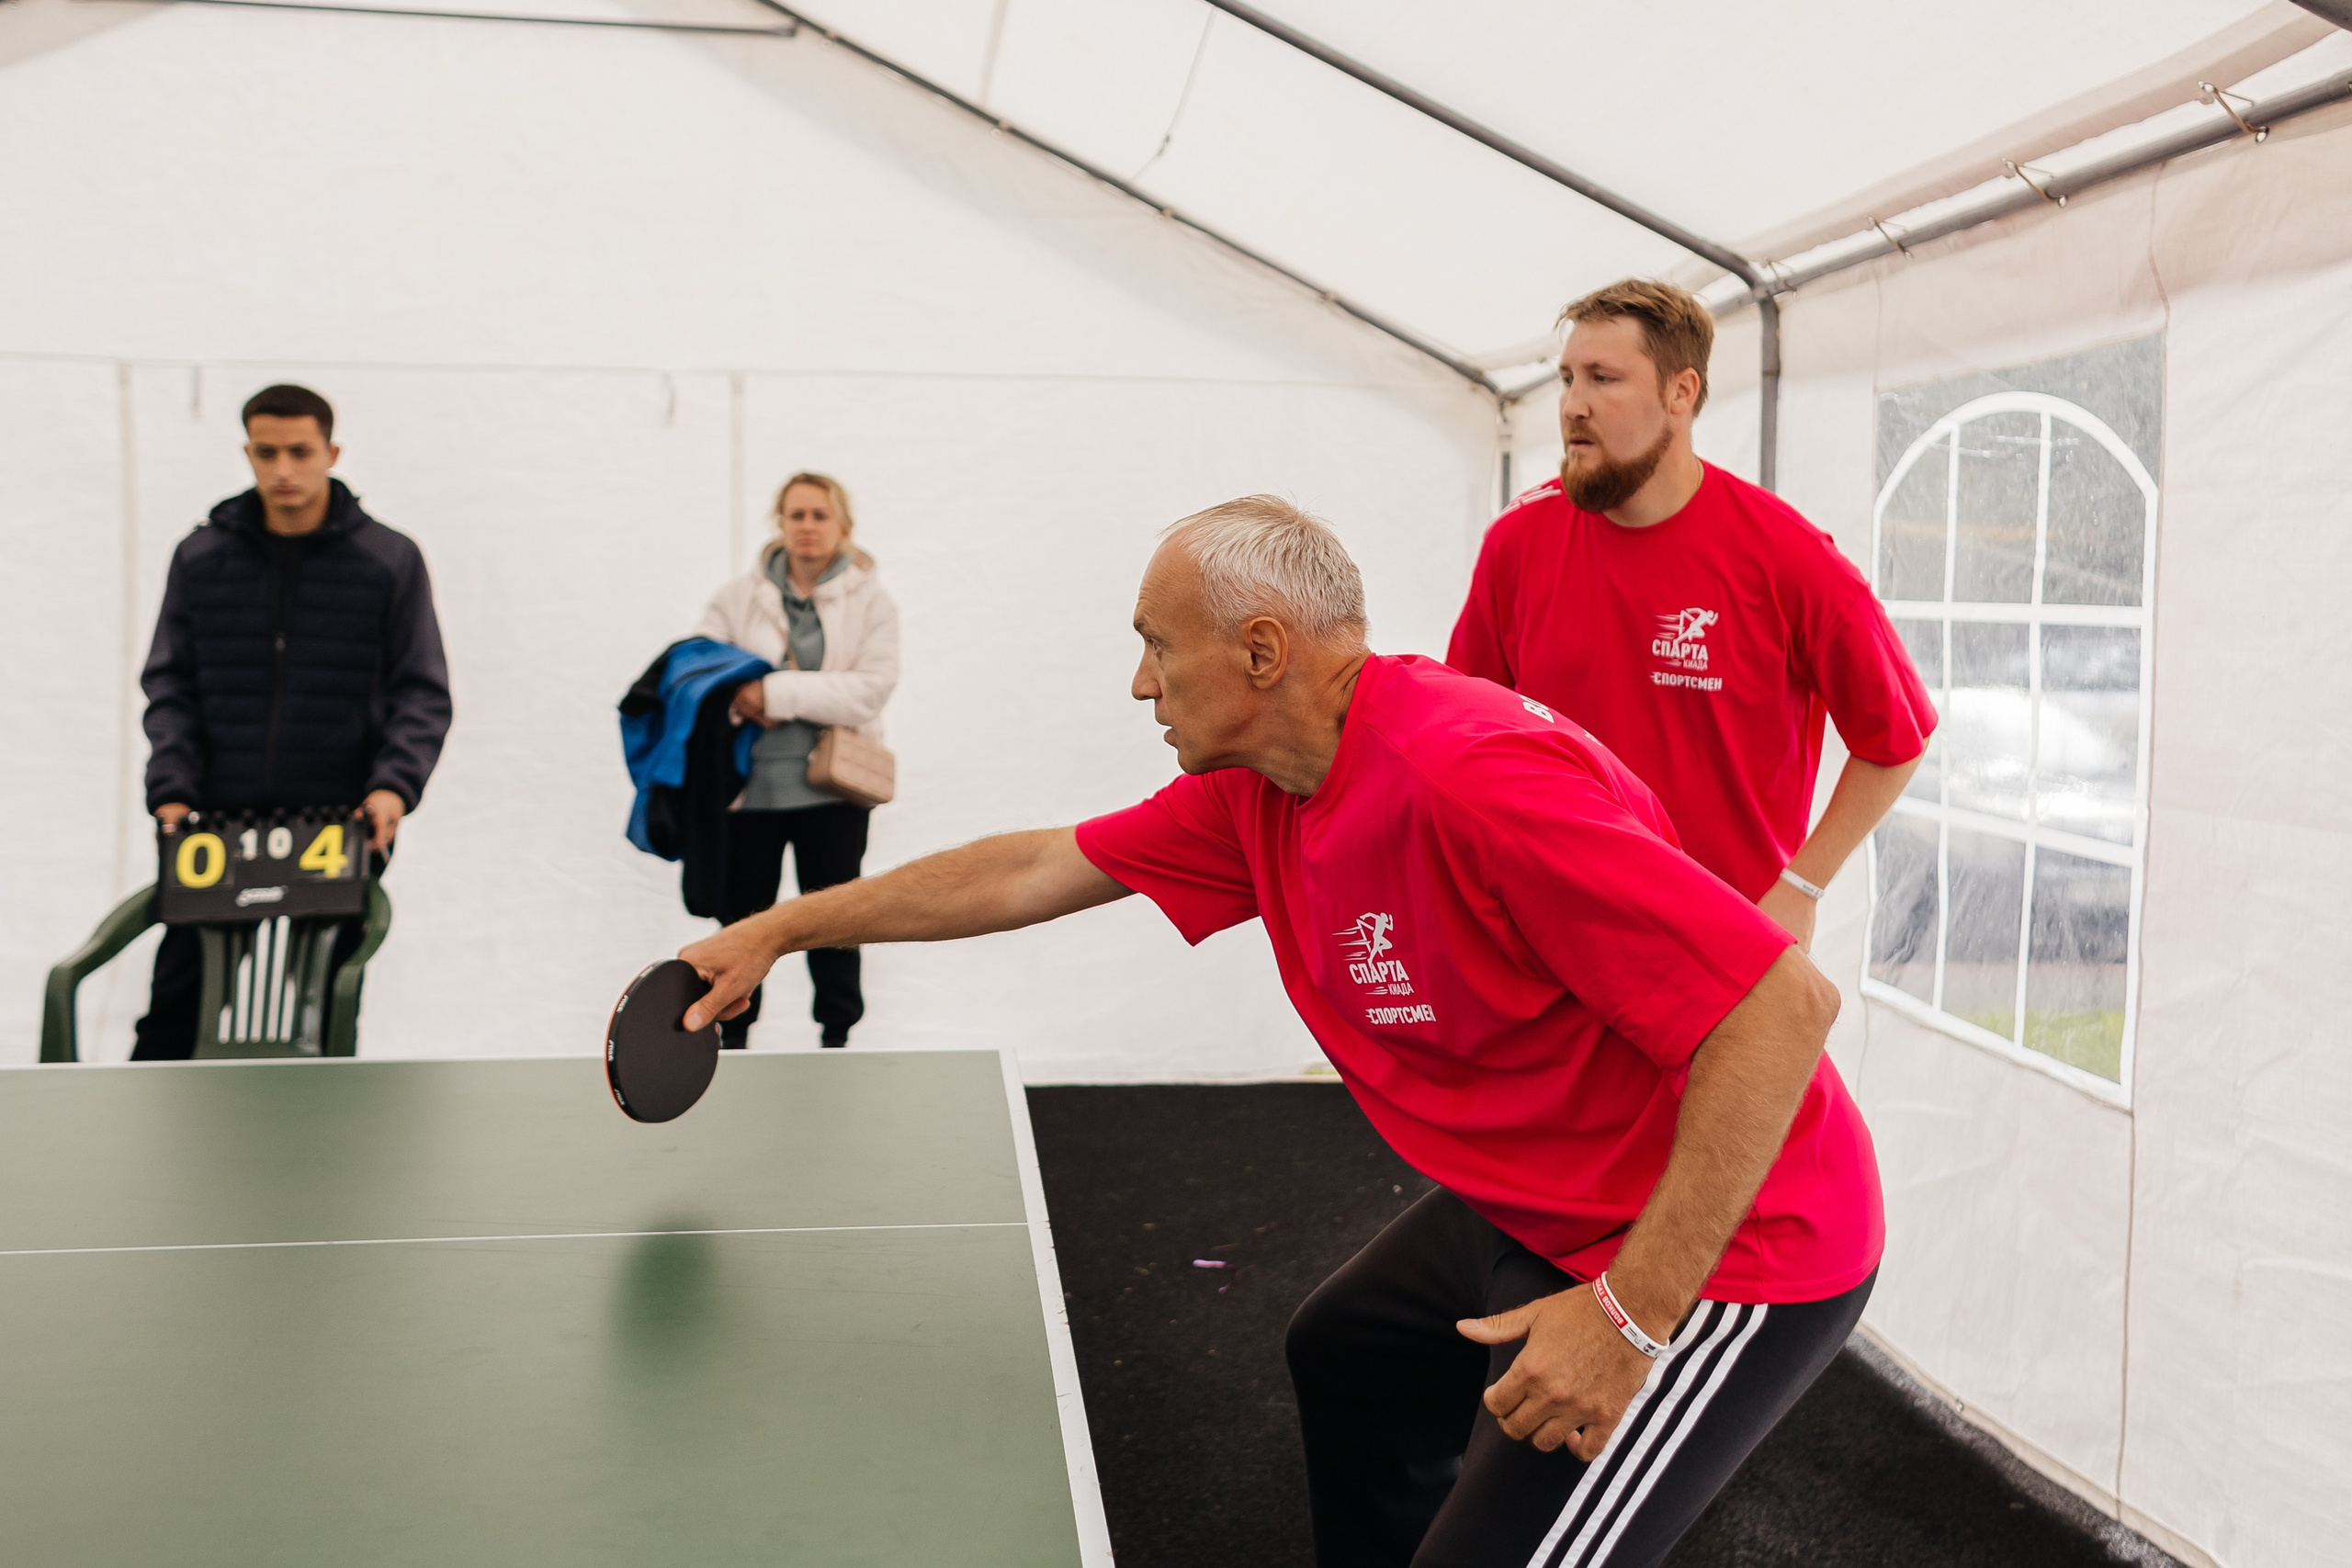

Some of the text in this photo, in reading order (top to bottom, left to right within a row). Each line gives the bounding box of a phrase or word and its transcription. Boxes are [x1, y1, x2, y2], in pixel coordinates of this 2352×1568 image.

[1652, 639, 1708, 660] СПАРТА
[1683, 660, 1708, 671] КИАДА
[1653, 671, 1722, 691] СПОРТСМЕН
[175, 833, 226, 888] 0
[300, 825, 348, 878] 4
[1349, 960, 1409, 984] СПАРТА
[1388, 982, 1414, 996] КИАДА
[1602, 1295, 1624, 1325] ВОЛКОВ
